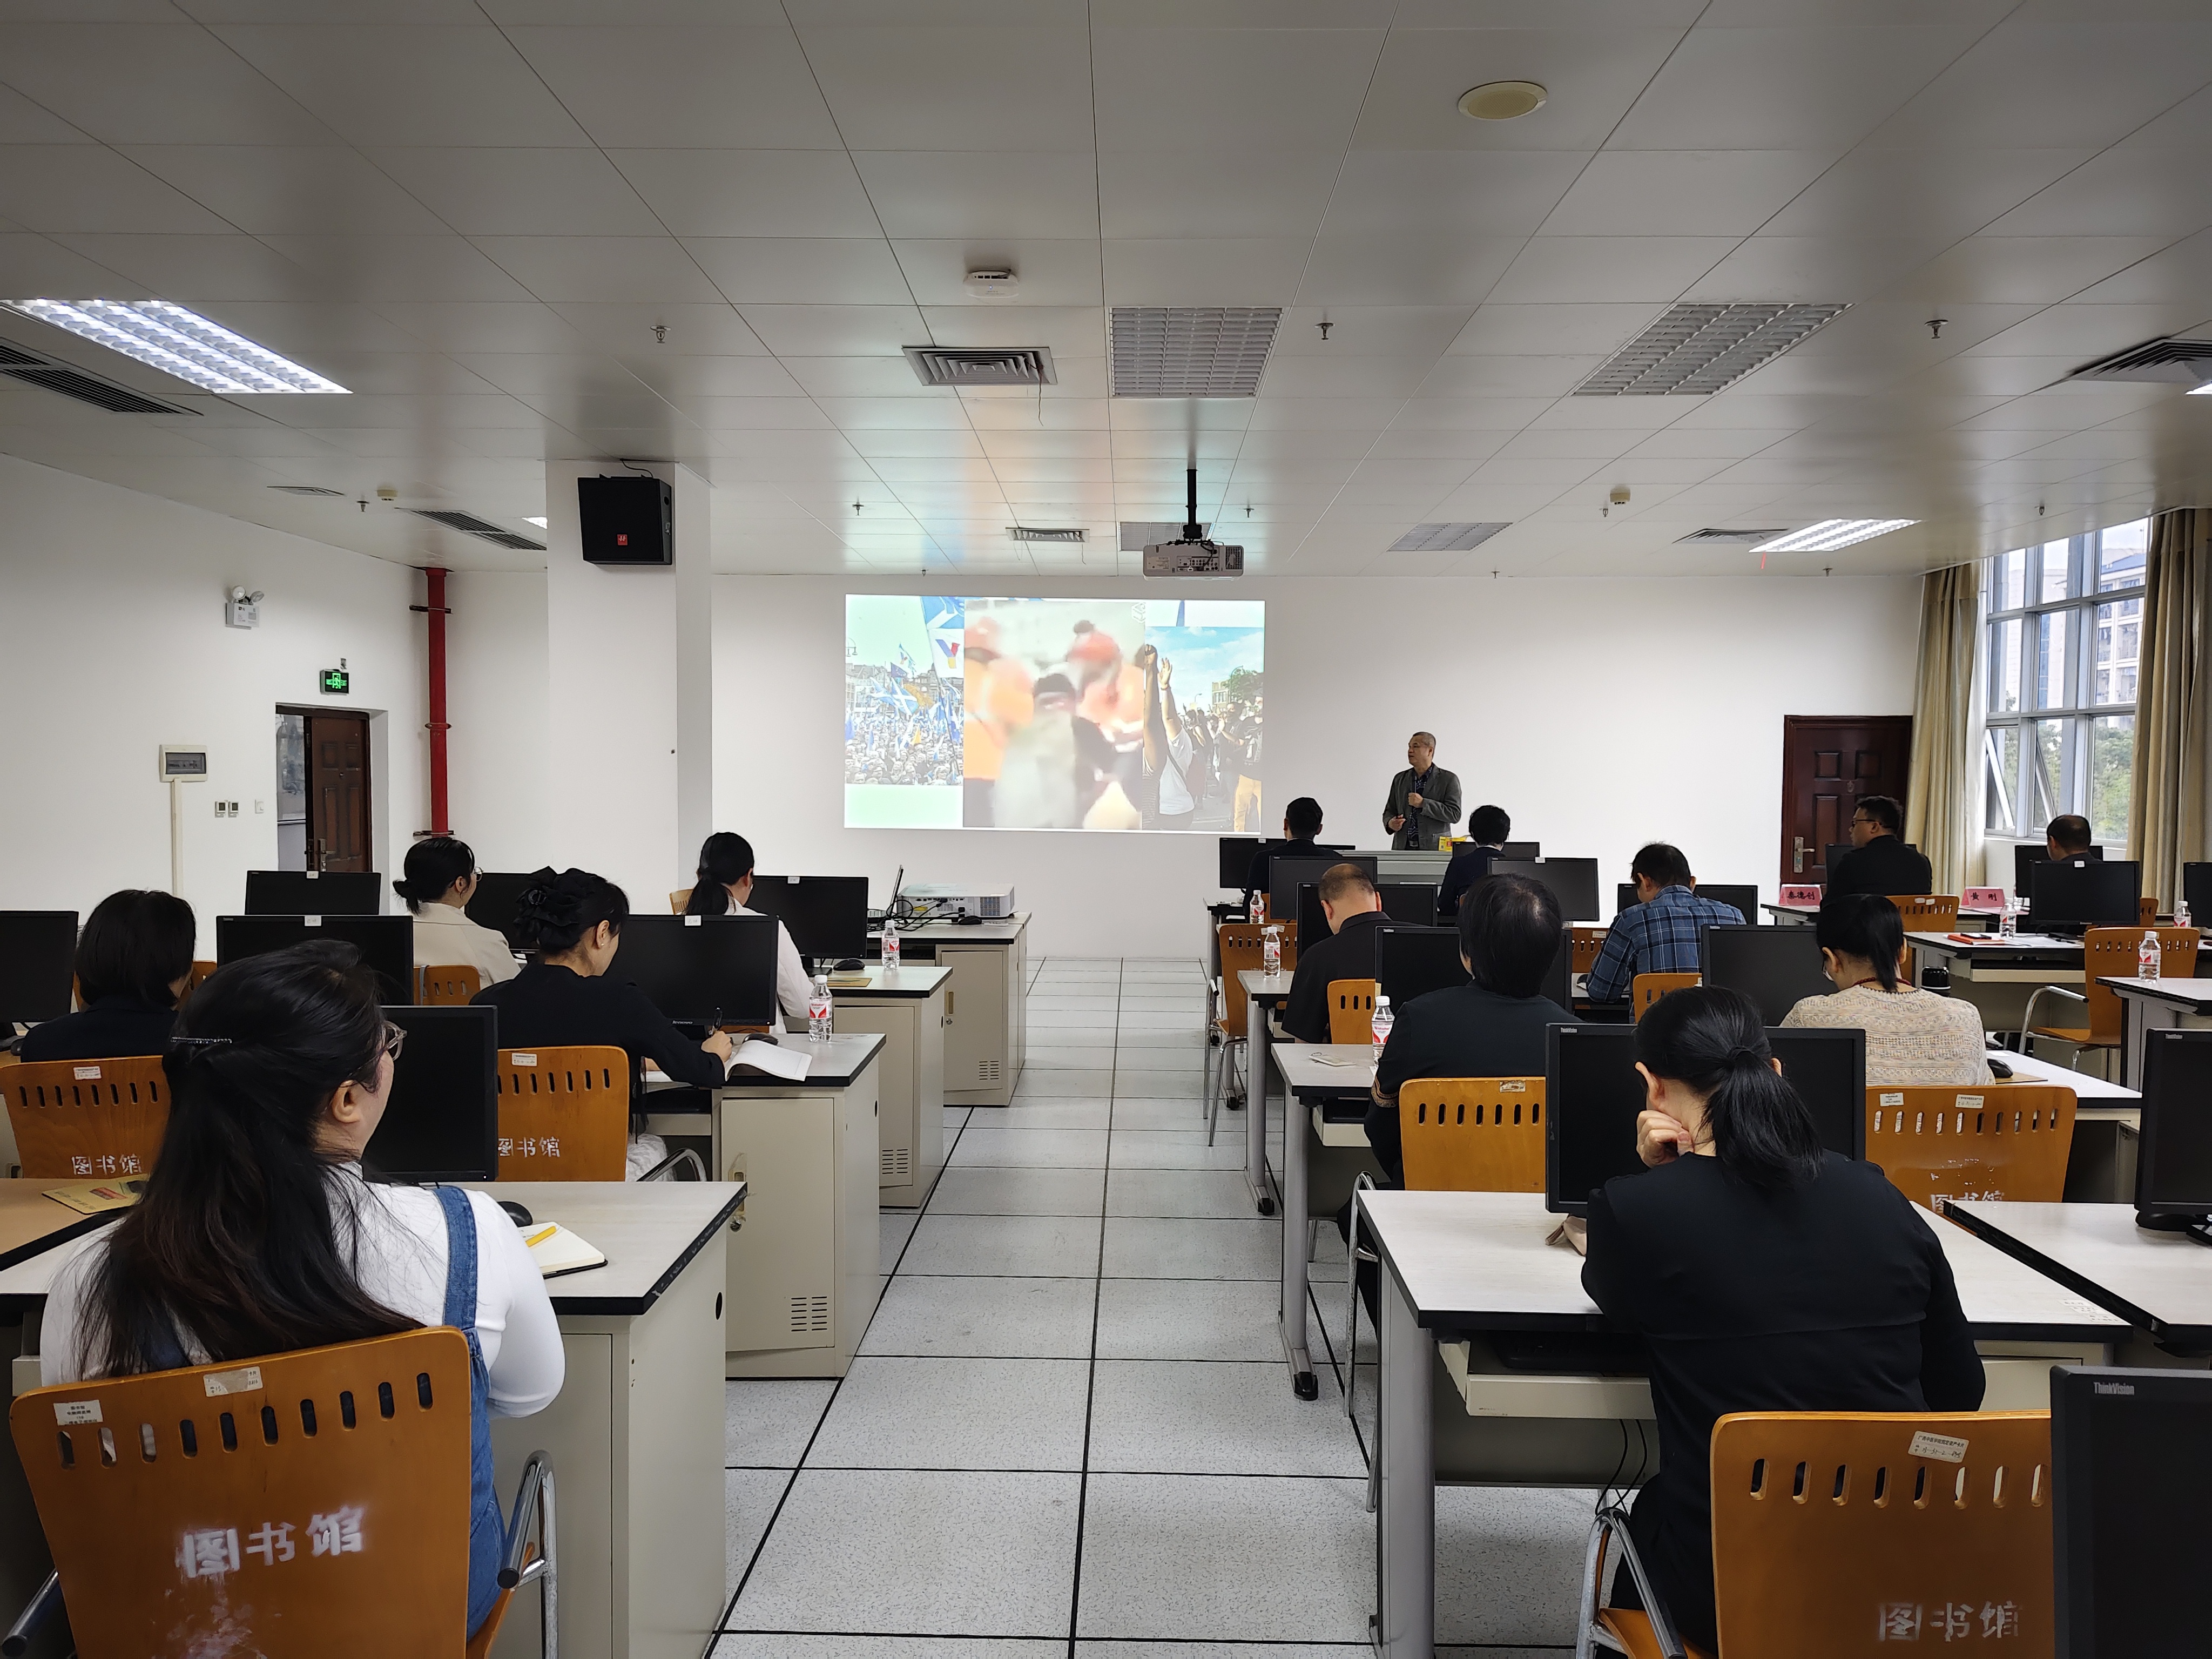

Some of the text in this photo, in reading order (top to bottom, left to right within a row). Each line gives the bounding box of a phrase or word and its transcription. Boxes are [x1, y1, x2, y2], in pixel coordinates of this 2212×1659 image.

[498, 1136, 560, 1158] 图书馆
[71, 1154, 142, 1175] 图书馆
[2093, 1382, 2135, 1395] ThinkVision
[179, 1505, 364, 1579] 图书馆
[1877, 1600, 2020, 1642] 图书馆
